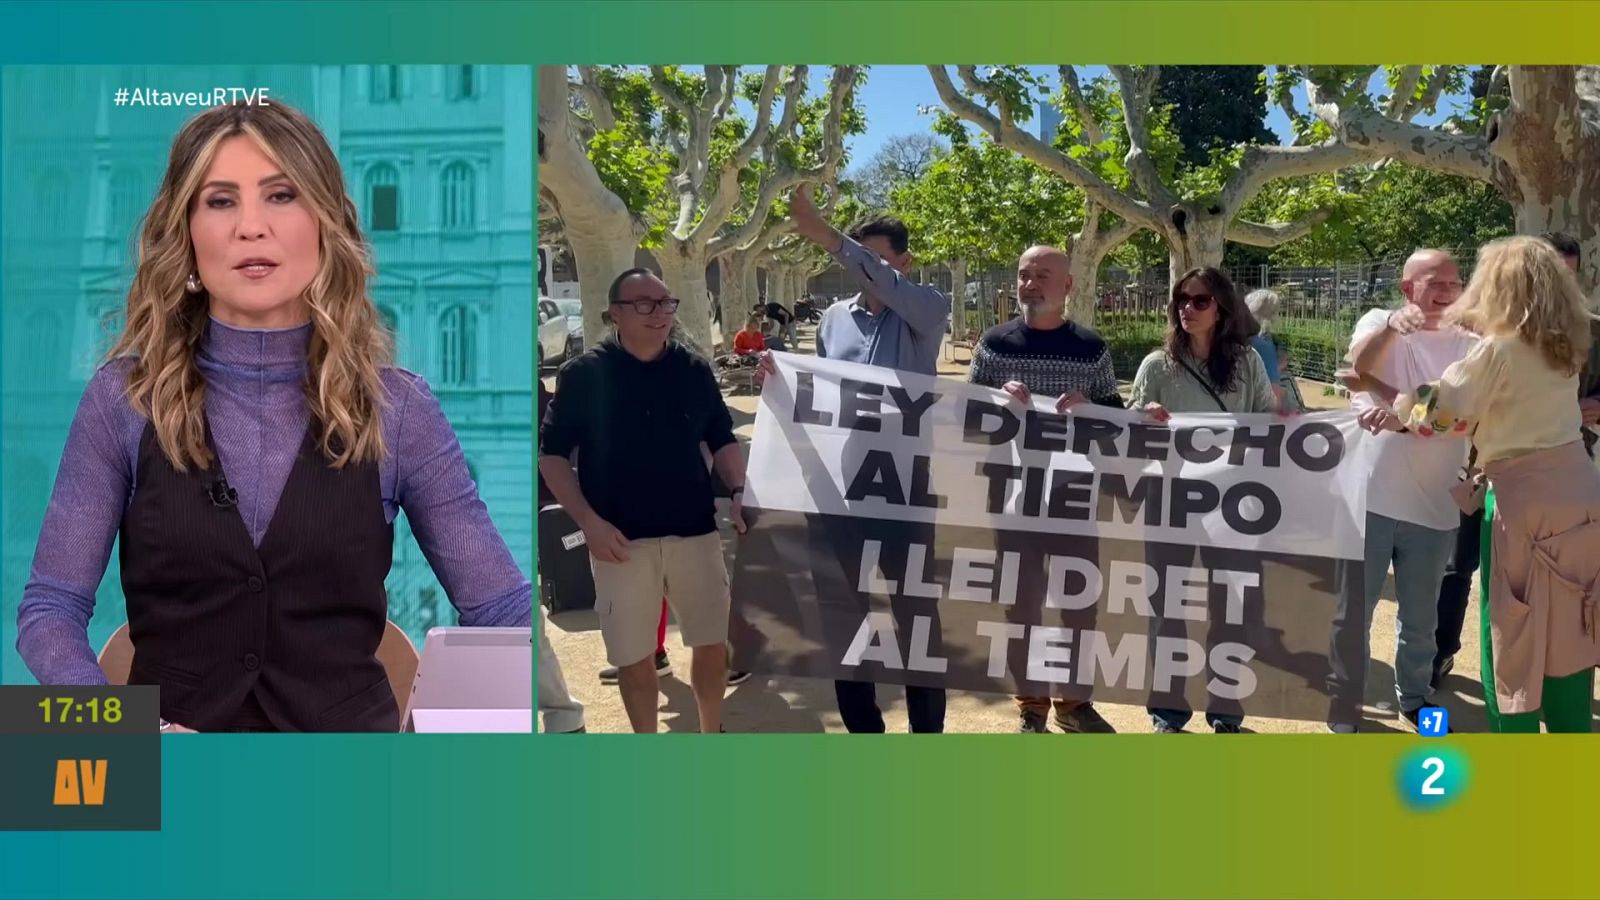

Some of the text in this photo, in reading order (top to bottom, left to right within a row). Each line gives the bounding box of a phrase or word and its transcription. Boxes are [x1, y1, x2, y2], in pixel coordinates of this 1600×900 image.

[792, 371, 1346, 472] LEY DERECHO
[844, 449, 1282, 535] AL TIEMPO
[857, 539, 1260, 625] LLEI DRET
[840, 611, 1258, 700] AL TEMPS
